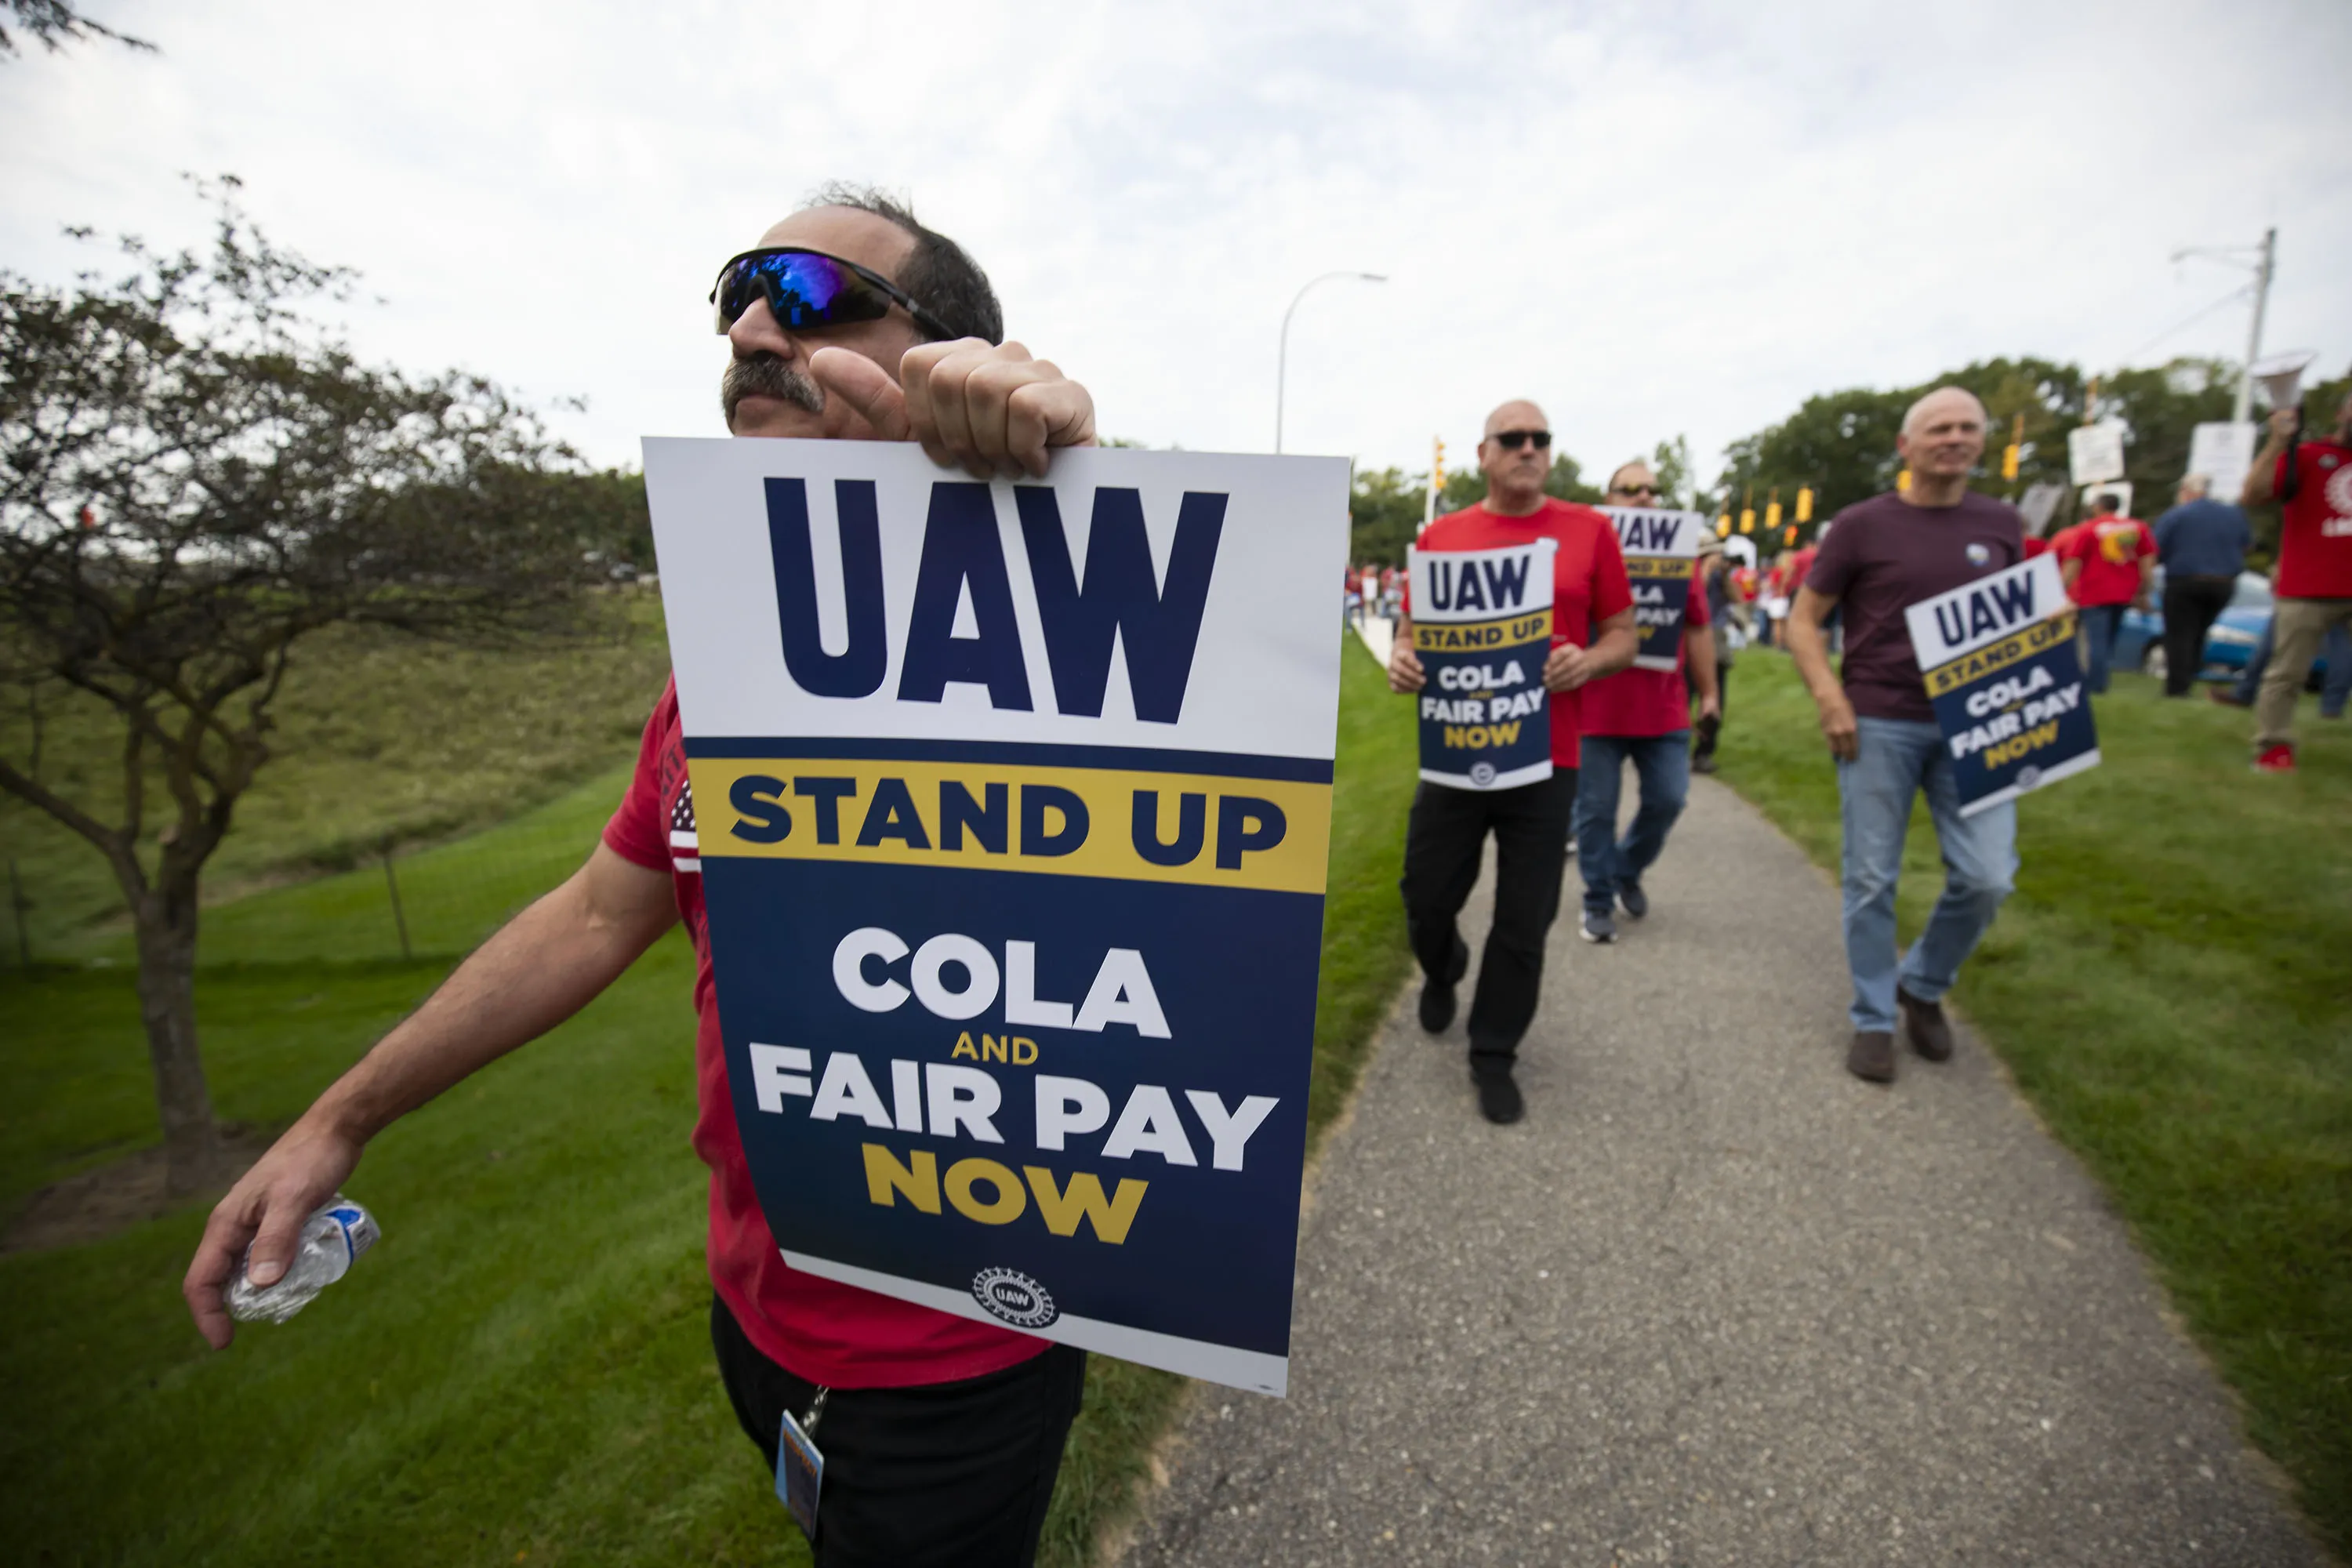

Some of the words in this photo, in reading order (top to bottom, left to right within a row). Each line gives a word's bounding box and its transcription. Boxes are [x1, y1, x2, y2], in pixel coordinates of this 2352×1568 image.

[764, 477, 1229, 724] UAW
[1429, 554, 1530, 610] UAW
[1632, 585, 1665, 604] LA
[1934, 569, 2034, 648] UAW
[1419, 626, 1503, 648] STAND
[1512, 618, 1544, 640] UP
[1937, 641, 2020, 687] STAND
[2031, 623, 2063, 647] UP
[1439, 660, 1525, 691] COLA
[1966, 666, 2053, 716] COLA
[1421, 695, 1484, 724] FAIR
[1490, 686, 1546, 722] PAY
[1951, 713, 2021, 758] FAIR
[2024, 681, 2082, 727] PAY
[1444, 721, 1520, 749] NOW
[1984, 720, 2059, 769] NOW
[728, 775, 1089, 857] STAND
[1131, 789, 1287, 869] UP
[832, 927, 1172, 1039] COLA
[951, 1031, 1039, 1066] AND
[749, 1042, 1005, 1144] FAIR
[1036, 1074, 1280, 1171] PAY
[862, 1142, 1149, 1245] NOW
[996, 1287, 1029, 1306] UAW
